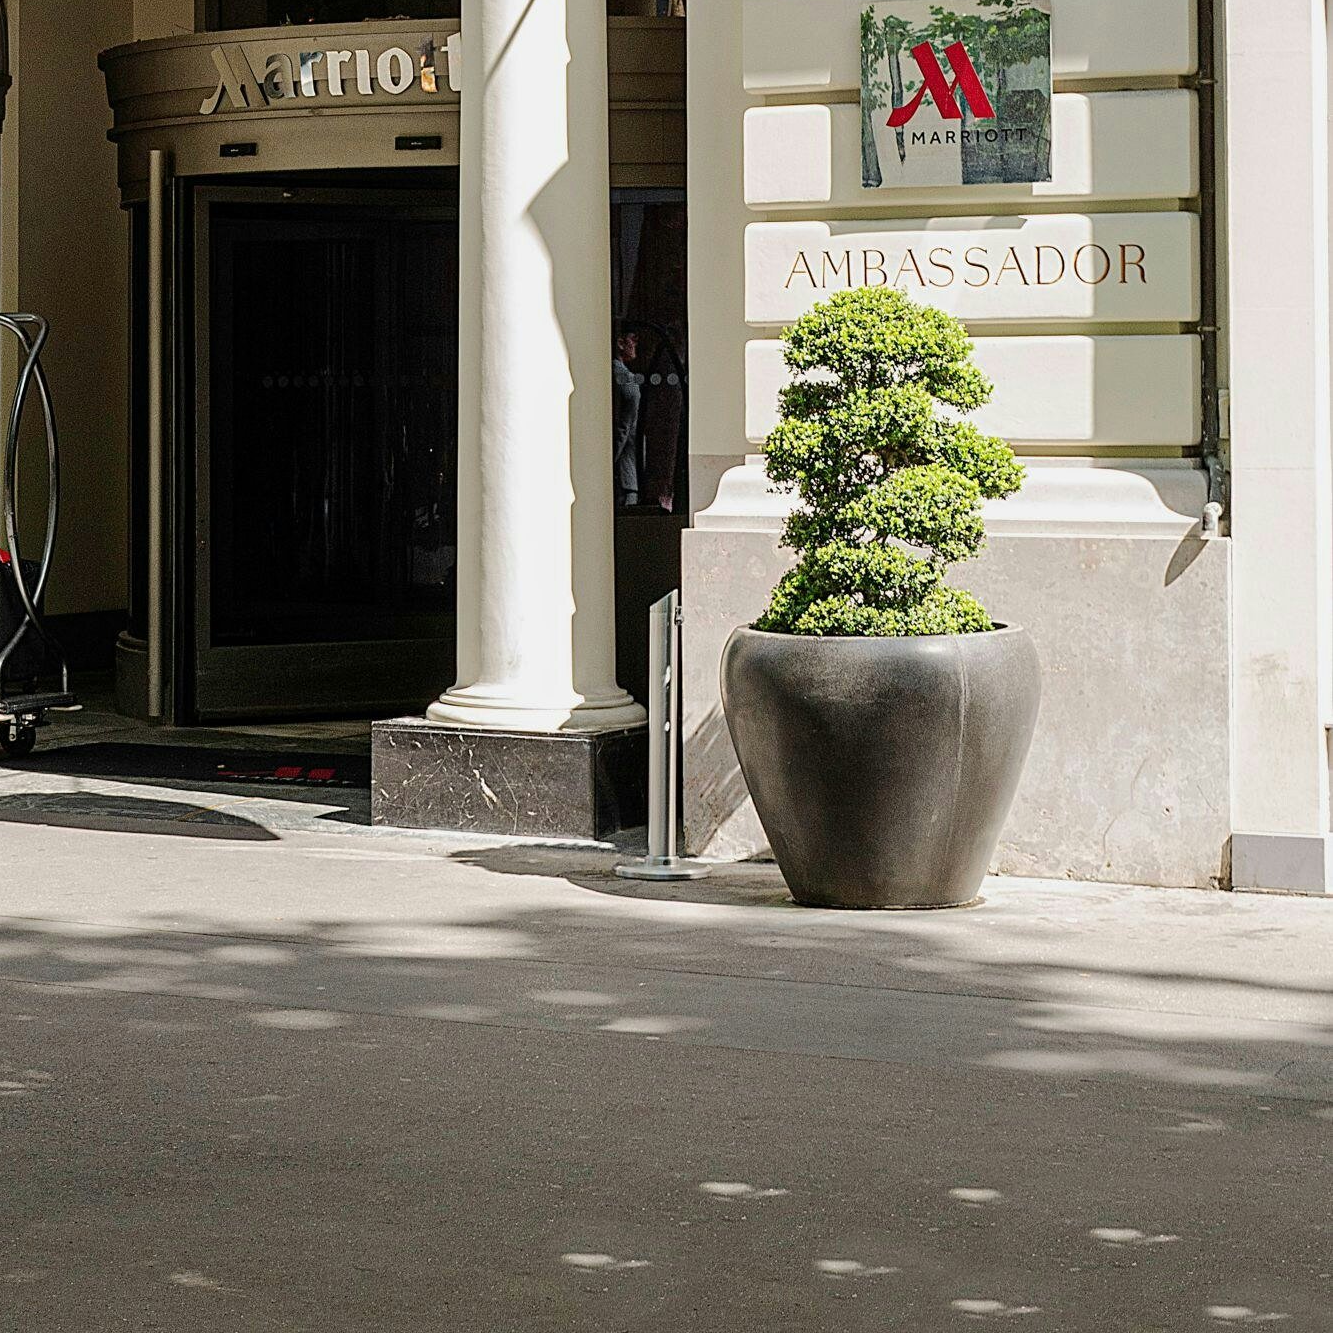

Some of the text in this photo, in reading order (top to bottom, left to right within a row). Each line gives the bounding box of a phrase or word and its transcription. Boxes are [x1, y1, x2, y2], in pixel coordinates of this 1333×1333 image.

[199, 31, 462, 115] Marriott
[911, 128, 1027, 145] MARRIOTT
[784, 244, 1148, 289] AMBASSADOR
